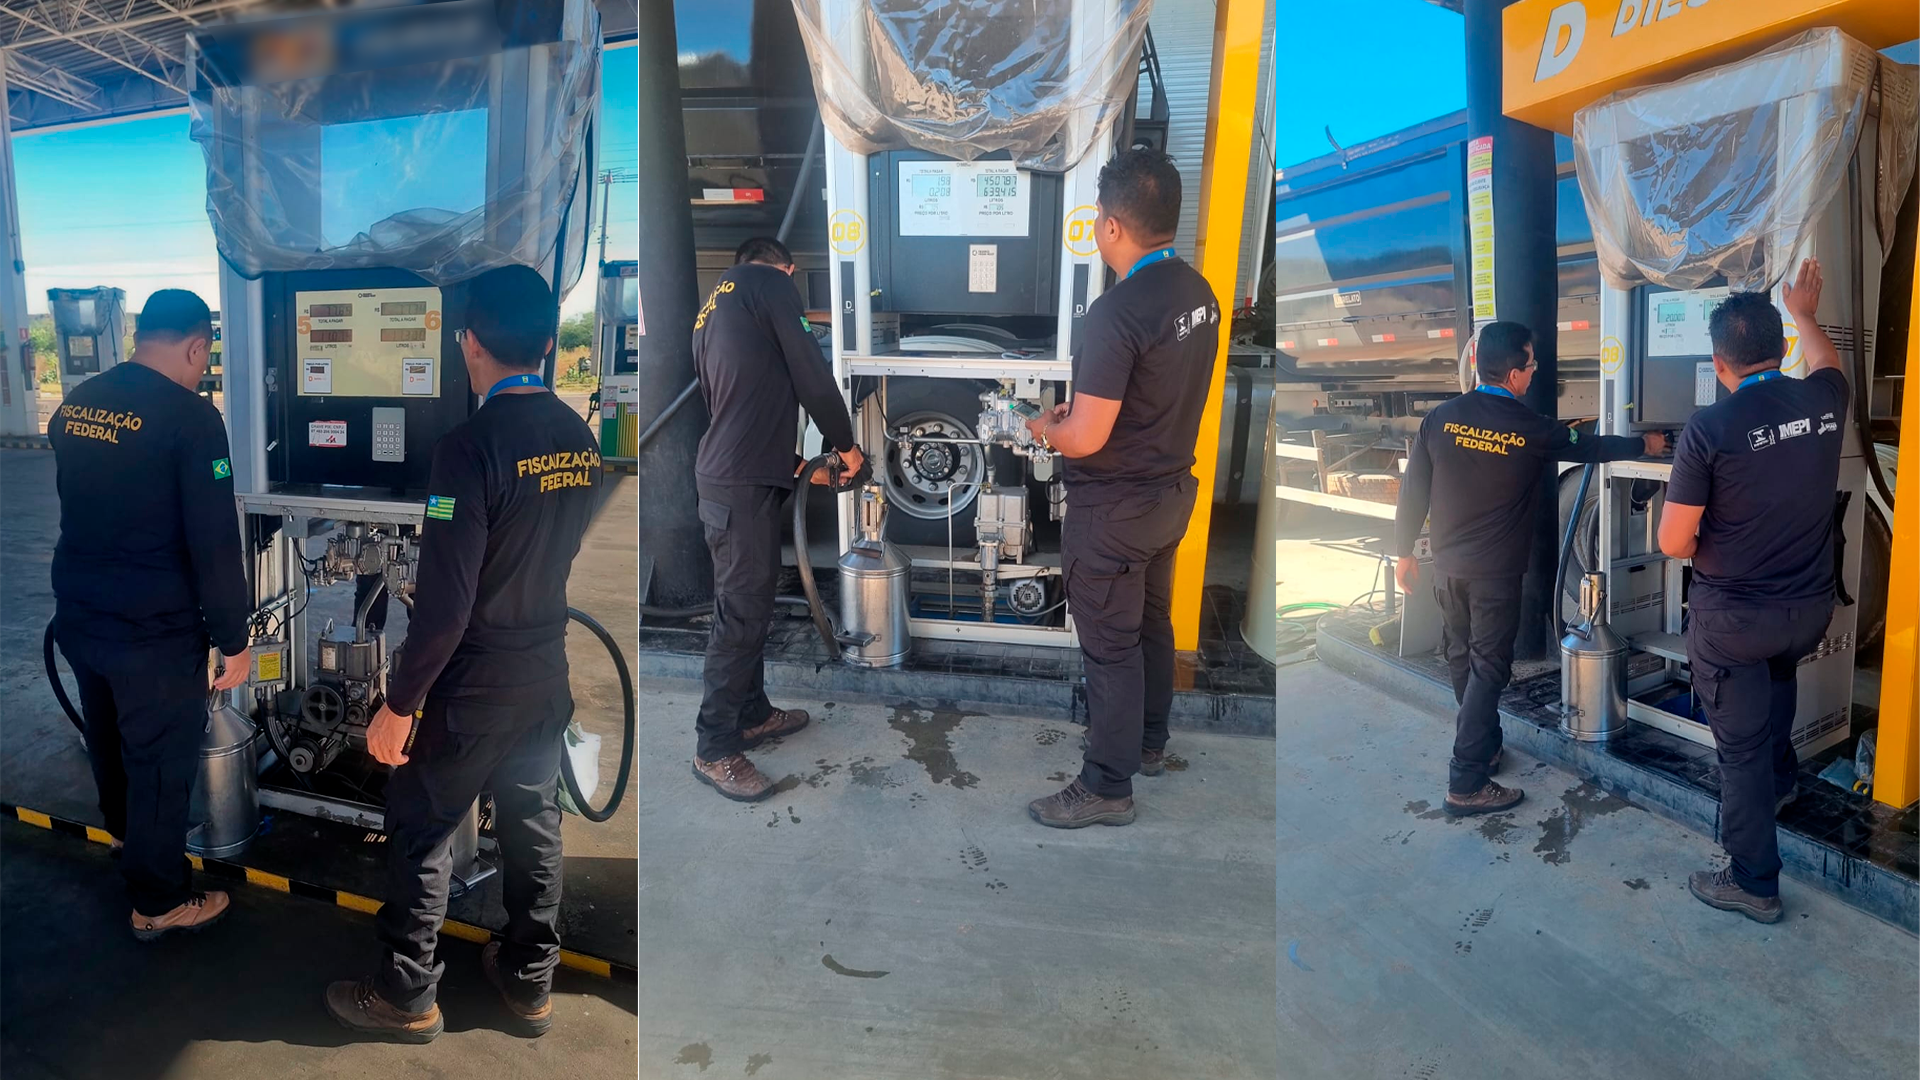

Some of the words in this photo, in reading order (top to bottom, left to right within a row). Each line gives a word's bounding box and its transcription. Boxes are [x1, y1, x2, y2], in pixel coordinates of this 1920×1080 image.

[1533, 1, 1587, 83] D
[832, 222, 860, 242] 08
[1068, 220, 1095, 241] 07
[846, 300, 852, 309] D
[1077, 304, 1083, 313] D
[298, 316, 312, 335] 5
[425, 310, 441, 330] 6
[1601, 346, 1619, 363] 08
[60, 405, 142, 431] FISCALIZAÇÃO
[1778, 418, 1811, 438] IMEPI
[65, 421, 119, 444] FEDERAL
[1443, 422, 1525, 447] FISCALIZAÇÃO
[1455, 436, 1508, 455] FEDERAL
